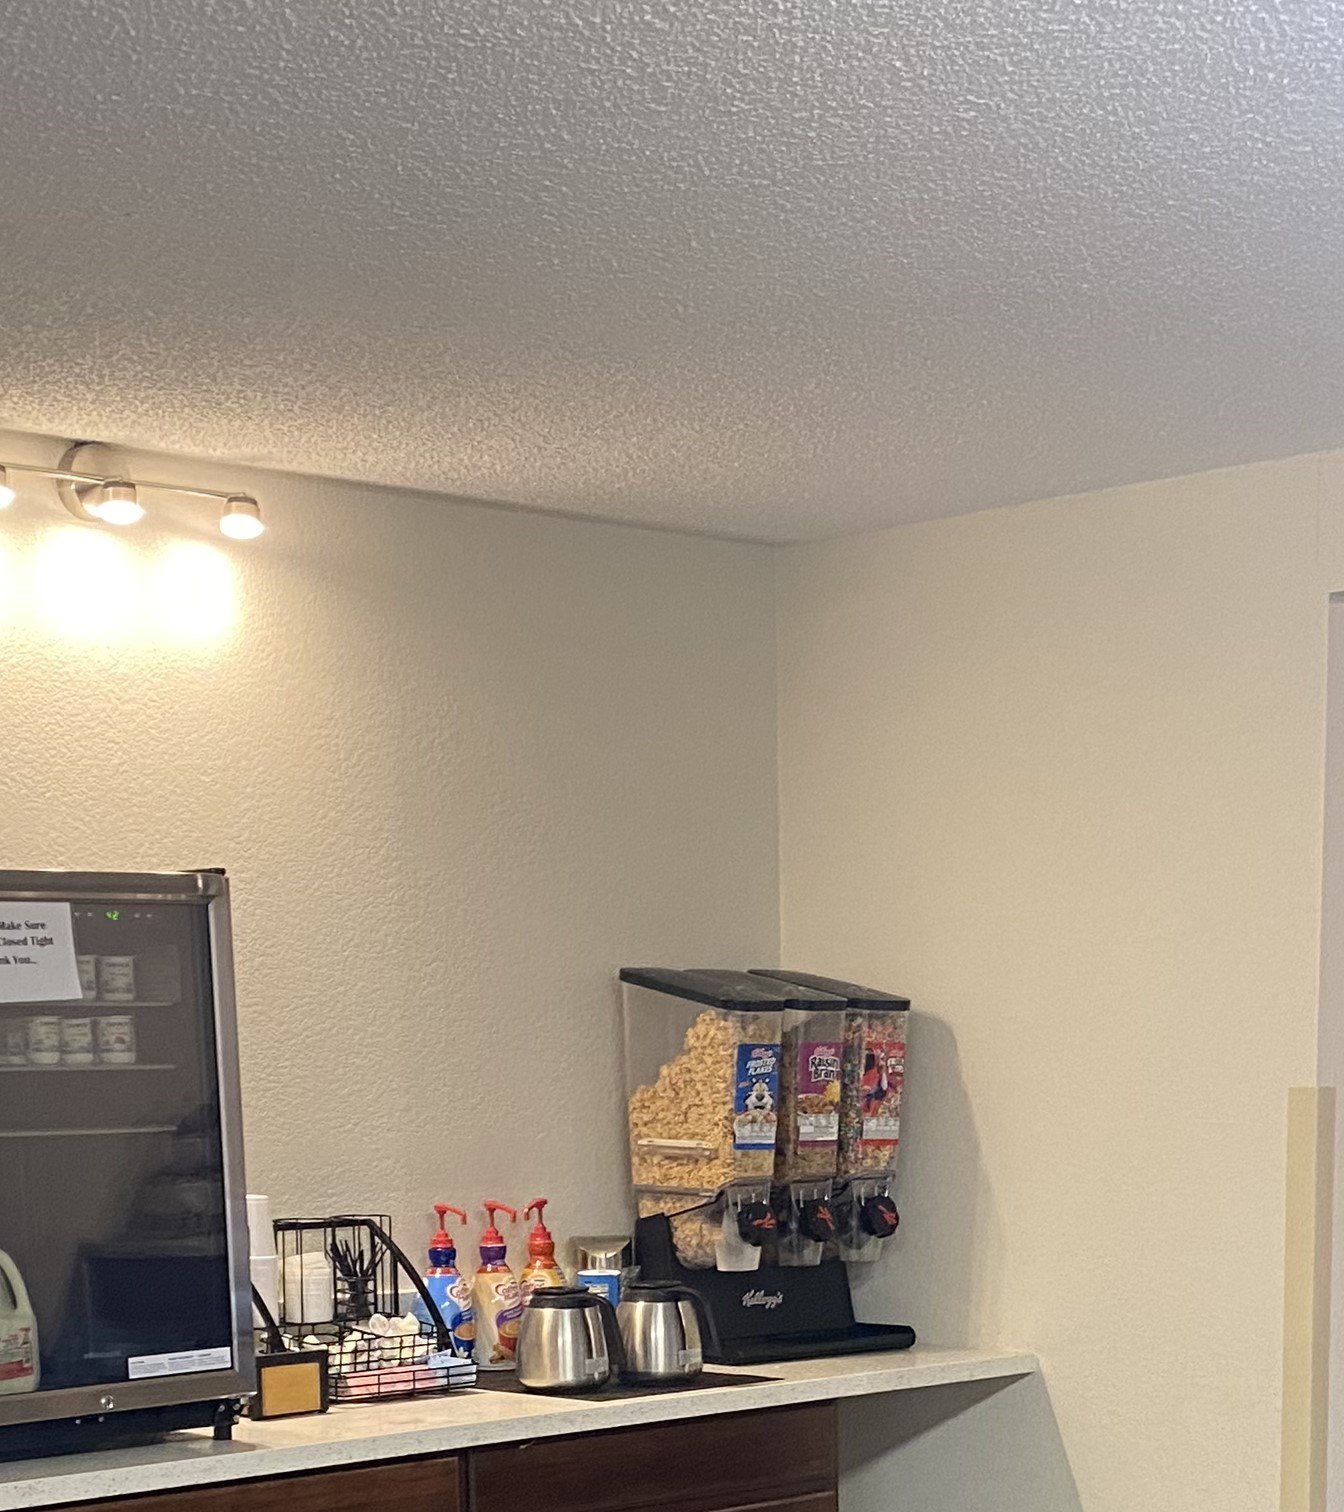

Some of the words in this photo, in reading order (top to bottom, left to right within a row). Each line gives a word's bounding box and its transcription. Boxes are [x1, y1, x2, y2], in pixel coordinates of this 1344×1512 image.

[25, 920, 46, 930] Sure
[31, 936, 54, 947] Tight
[810, 1056, 838, 1070] Raisin
[742, 1290, 784, 1309] Kellogg's
